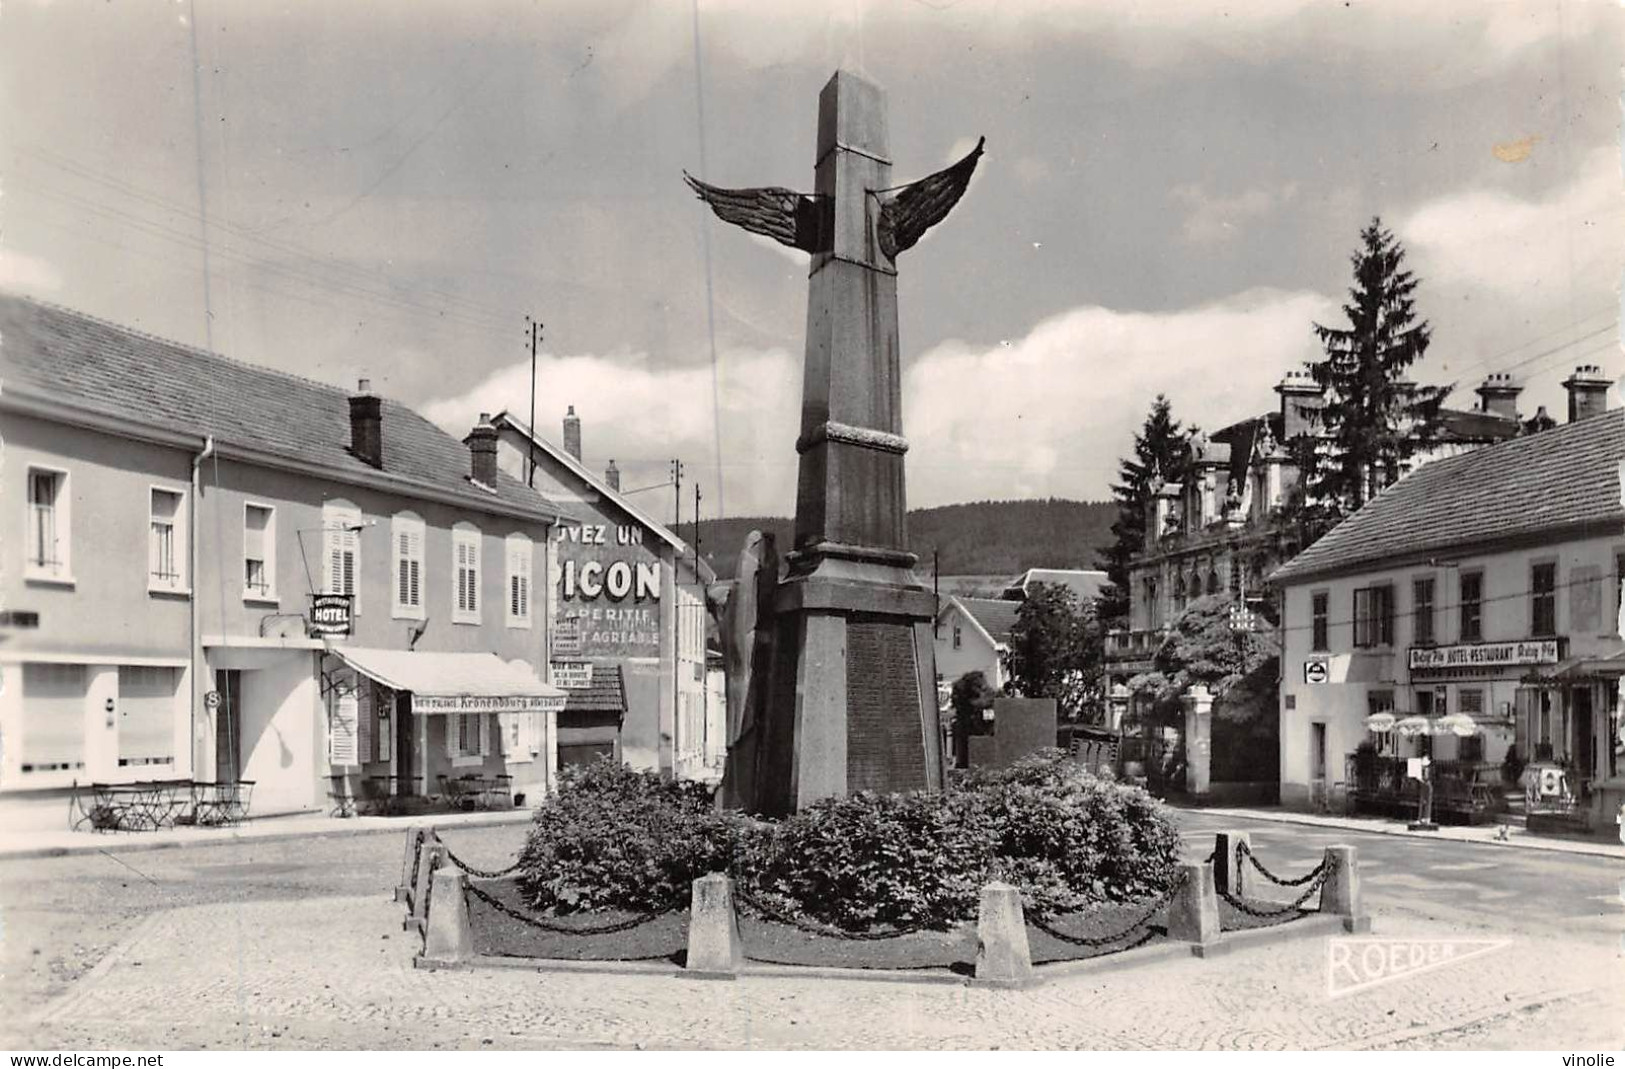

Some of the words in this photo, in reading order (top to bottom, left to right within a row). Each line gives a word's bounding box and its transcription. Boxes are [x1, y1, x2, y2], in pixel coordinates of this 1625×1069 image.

[617, 525, 643, 544] UN
[557, 560, 660, 599] ICON
[315, 608, 349, 621] HOTEL
[461, 696, 527, 709] Kronenbourg
